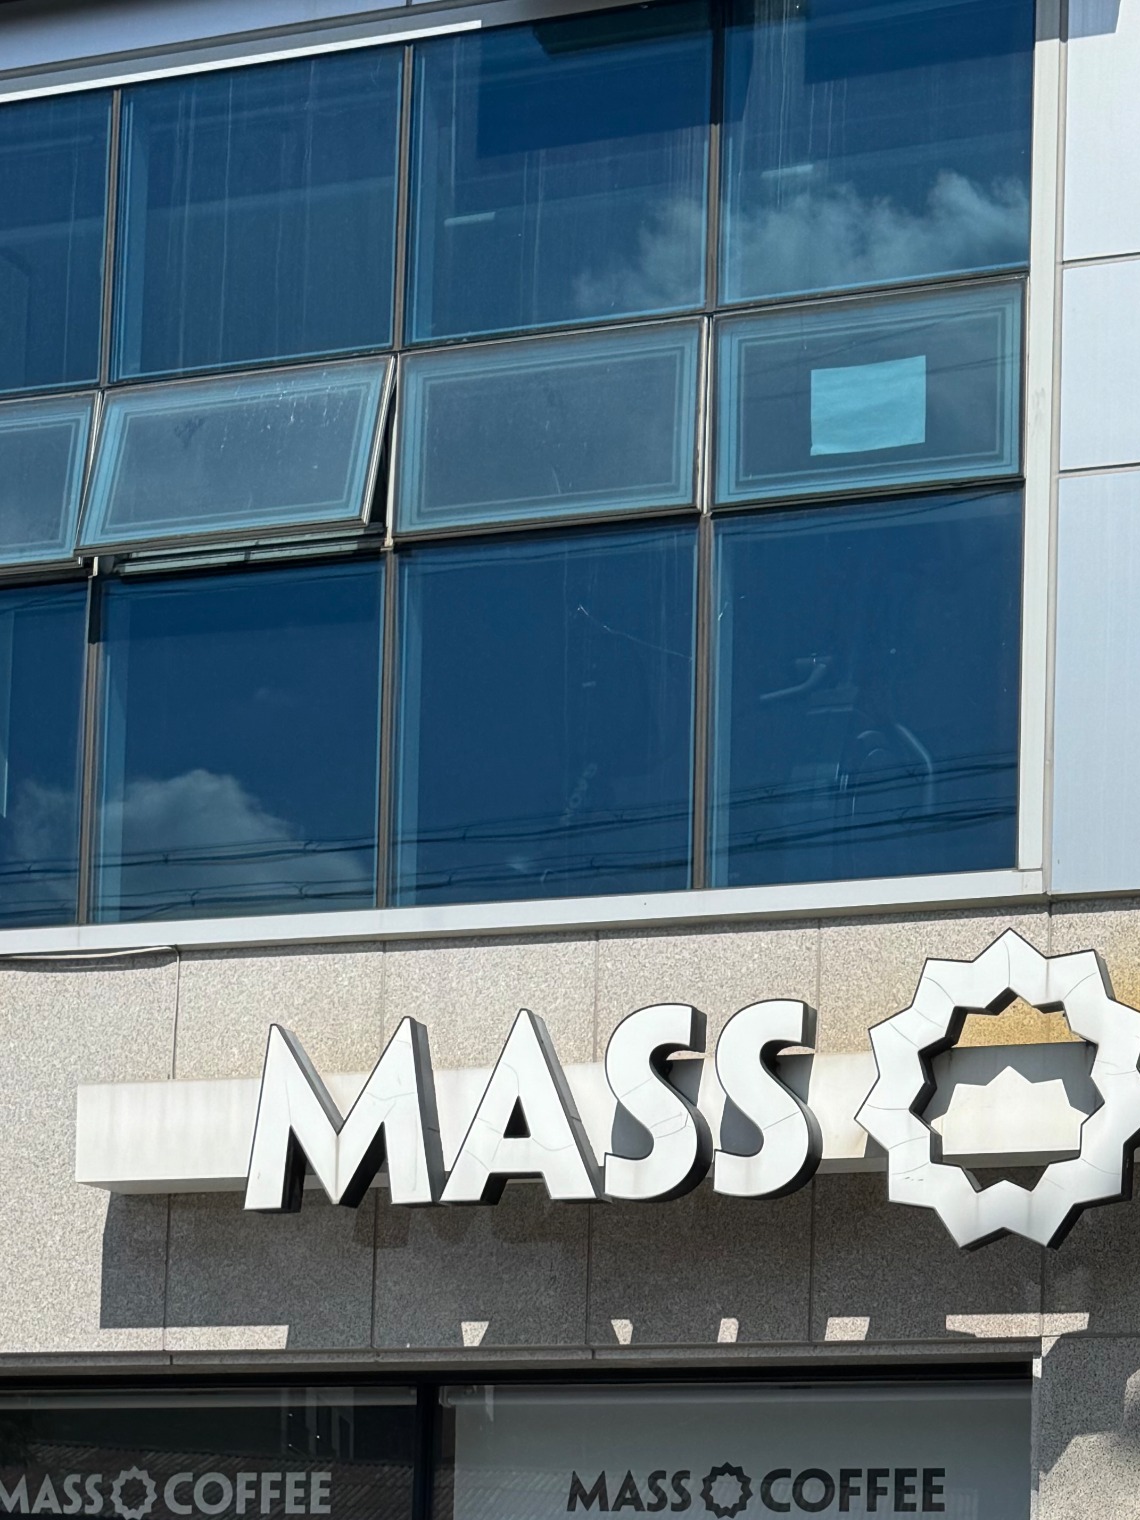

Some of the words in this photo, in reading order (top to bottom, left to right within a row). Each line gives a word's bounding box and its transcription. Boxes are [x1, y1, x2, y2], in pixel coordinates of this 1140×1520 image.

[244, 998, 822, 1212] MASS
[0, 1473, 104, 1514] MASS
[164, 1471, 332, 1514] COFFEE
[566, 1469, 691, 1512] MASS
[760, 1467, 946, 1513] COFFEE
